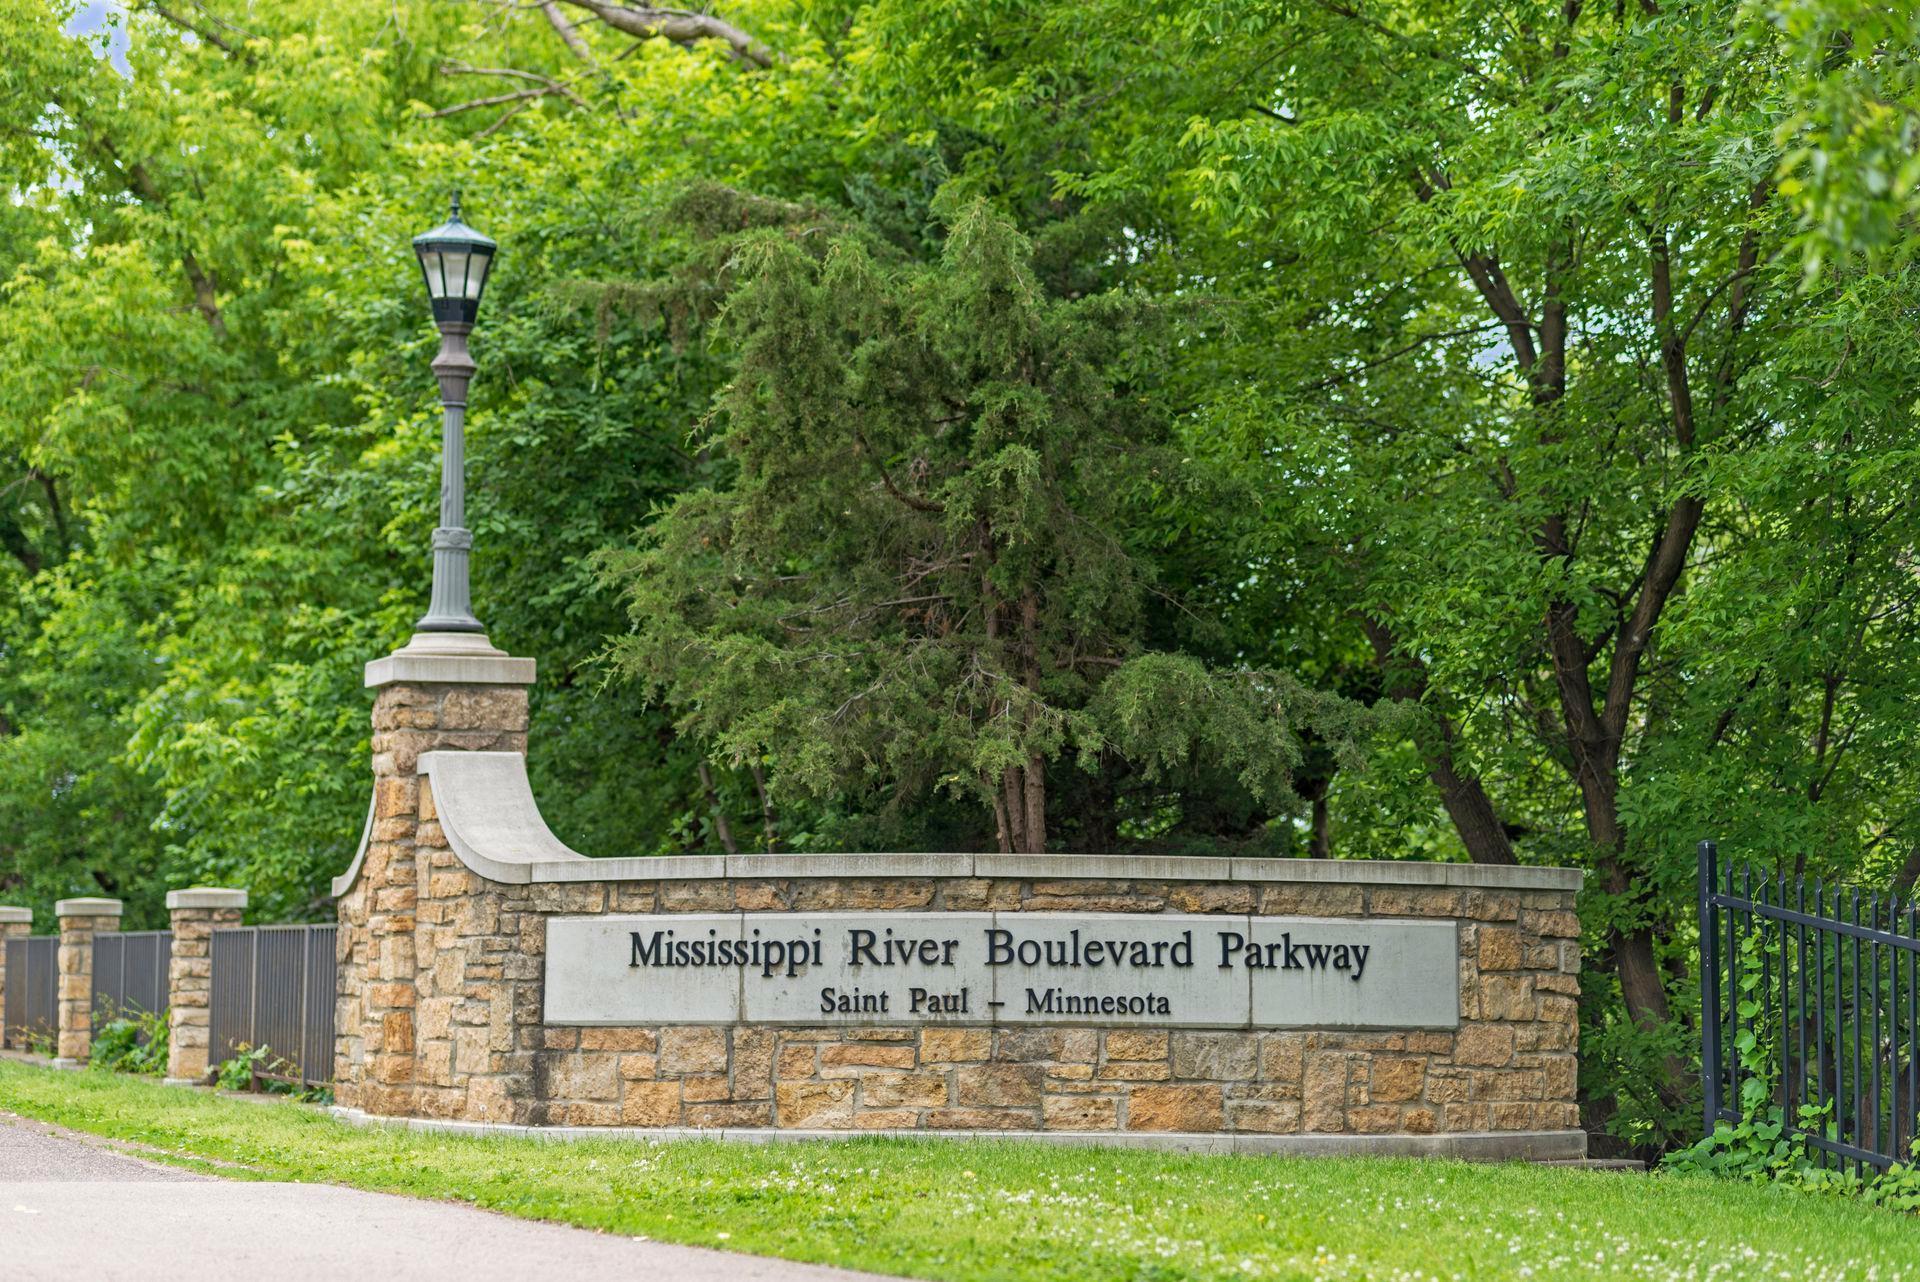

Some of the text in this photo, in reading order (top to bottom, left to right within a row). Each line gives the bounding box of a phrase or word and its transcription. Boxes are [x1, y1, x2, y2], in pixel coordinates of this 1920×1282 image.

[629, 928, 1371, 983] Mississippi River Boulevard Parkway
[820, 987, 889, 1015] Saint
[908, 987, 969, 1015] Paul
[1025, 987, 1172, 1016] Minnesota
